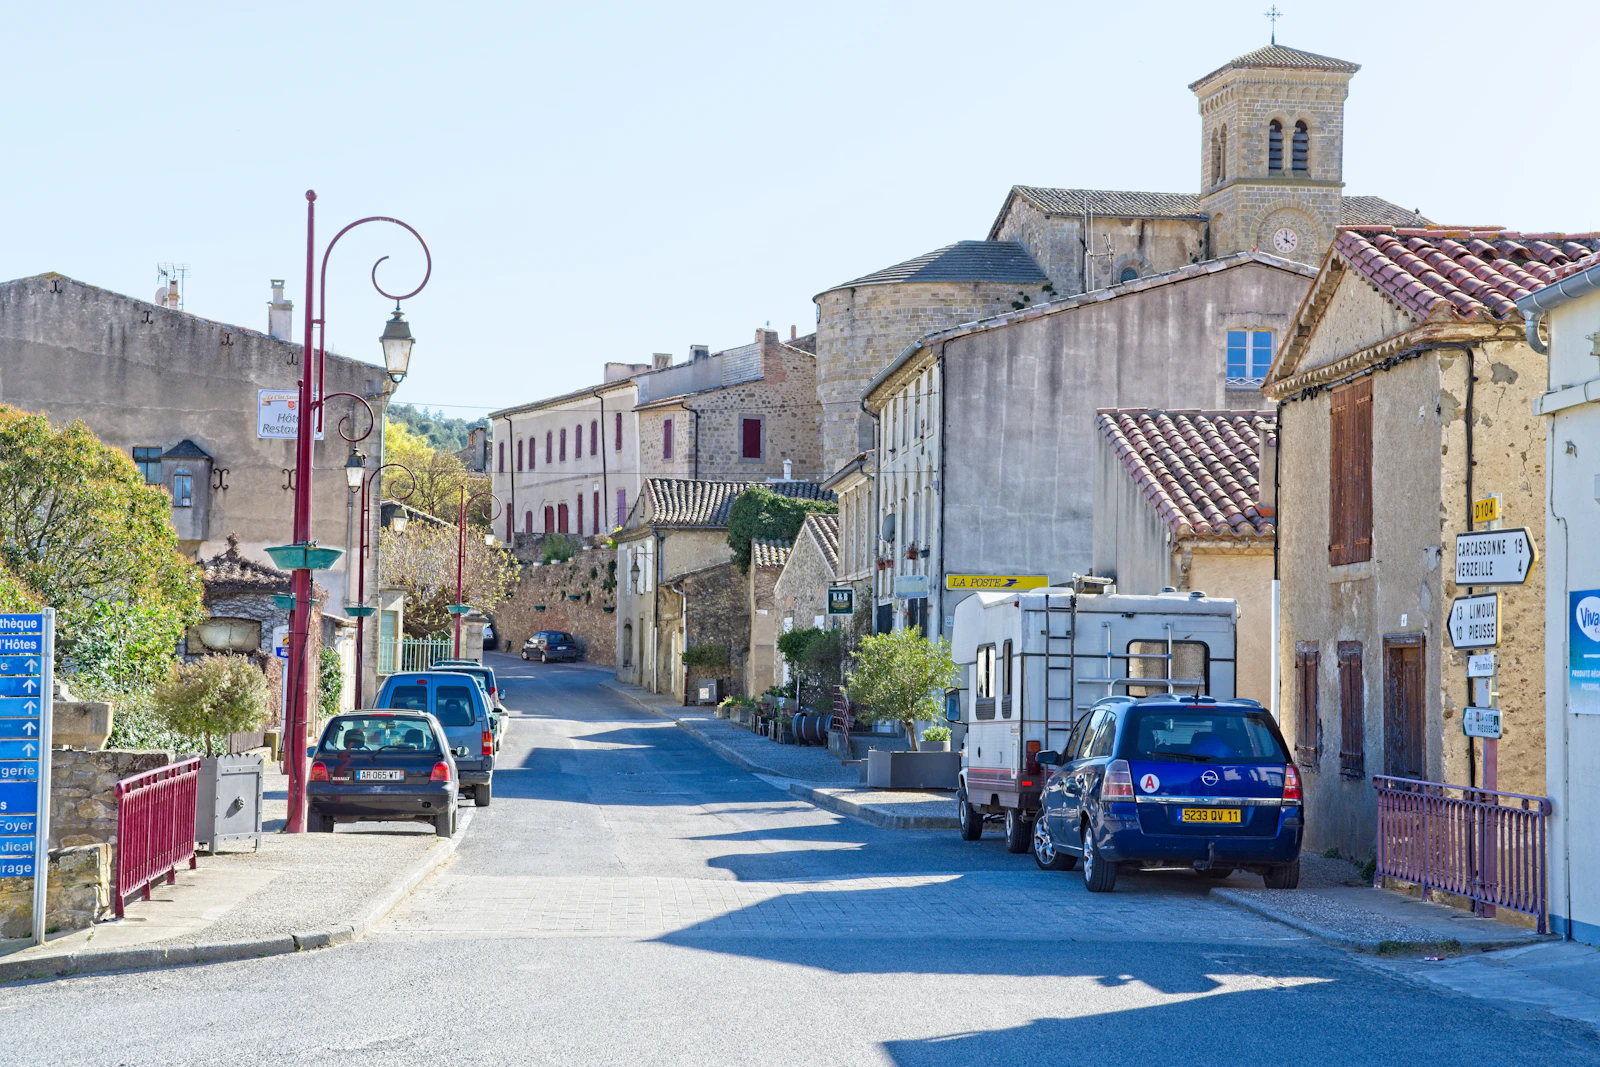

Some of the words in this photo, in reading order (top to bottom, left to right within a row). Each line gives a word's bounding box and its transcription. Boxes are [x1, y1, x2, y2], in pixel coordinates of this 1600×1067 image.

[277, 413, 300, 423] Hôt
[262, 424, 320, 435] Restau
[1481, 501, 1494, 517] 104
[1458, 539, 1506, 557] CARCASSONNE
[1514, 538, 1523, 554] 19
[1458, 561, 1493, 577] VERZEILLE
[1518, 560, 1523, 575] 4
[952, 578, 966, 587] LA
[970, 578, 1002, 587] POSTE
[1456, 606, 1463, 621] 13
[1469, 602, 1495, 620] LIMOUX
[1456, 626, 1463, 641] 10
[1469, 622, 1495, 640] PIEUSSE
[1, 765, 35, 778] gerie
[1145, 775, 1155, 789] A
[1184, 810, 1208, 821] 5233
[1211, 810, 1224, 821] QV
[1228, 810, 1238, 821] 11
[0, 864, 32, 875] rage
